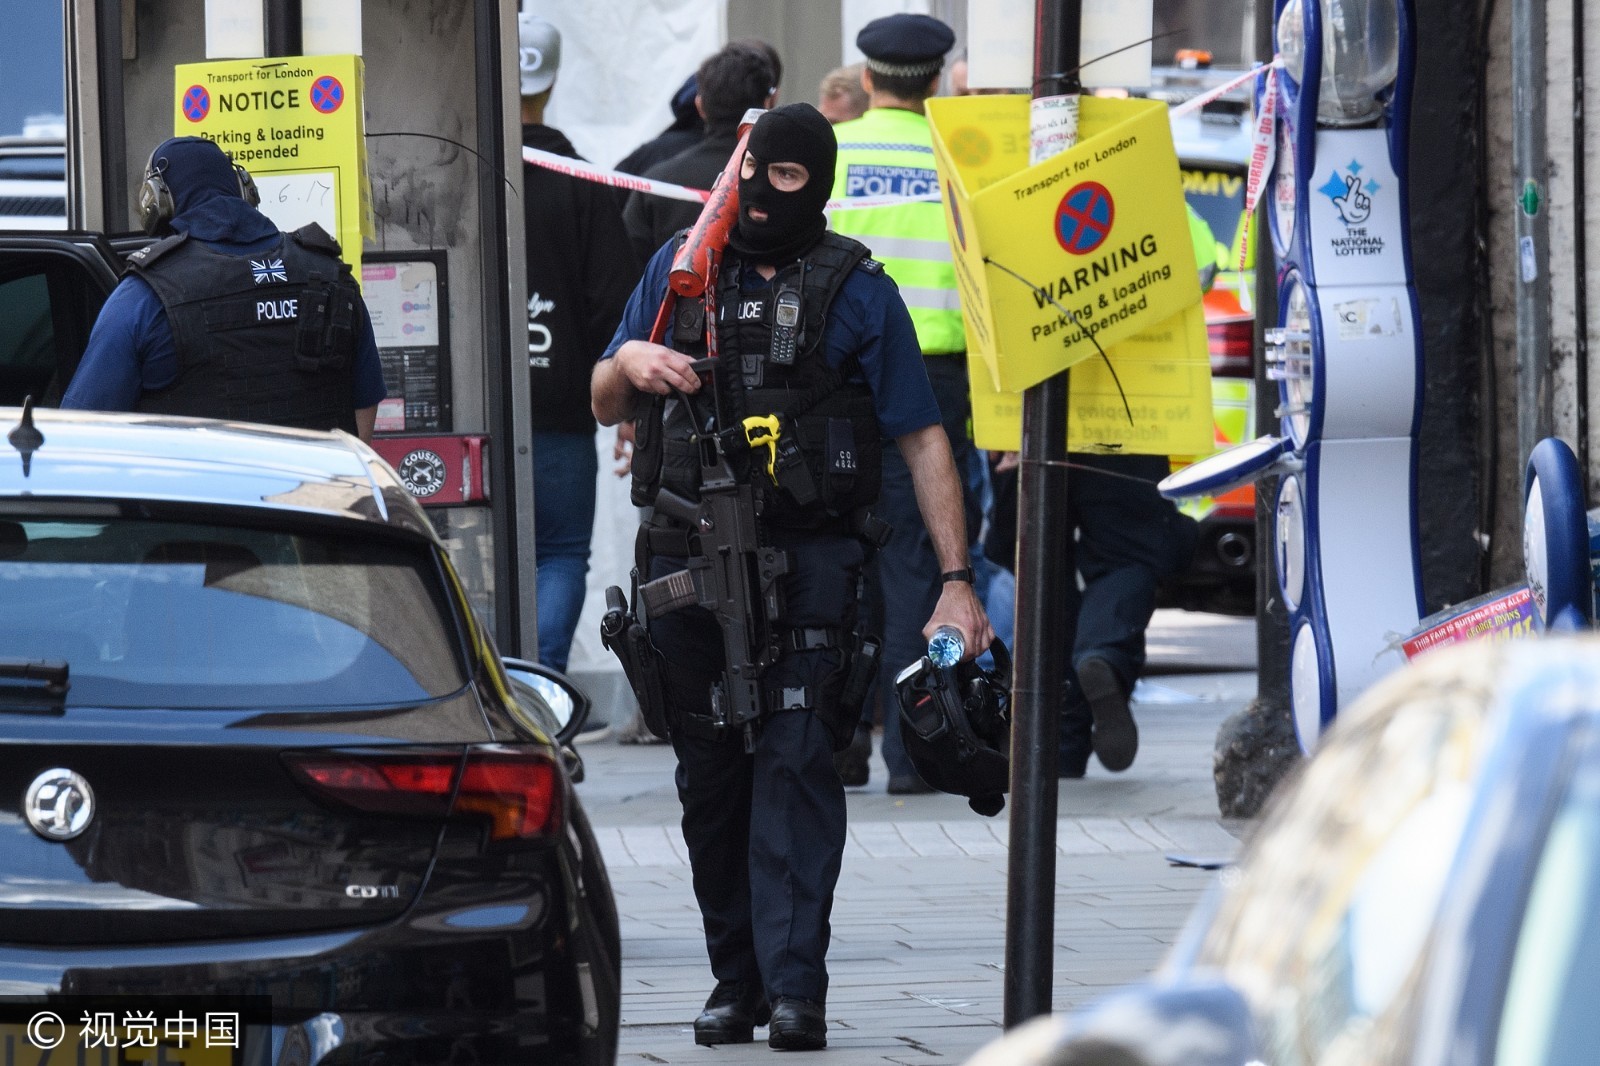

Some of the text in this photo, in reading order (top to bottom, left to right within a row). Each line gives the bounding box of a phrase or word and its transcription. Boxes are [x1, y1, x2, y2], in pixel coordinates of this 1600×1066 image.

[207, 68, 313, 84] Transport for London
[219, 89, 300, 113] NOTICE
[201, 126, 324, 145] Parking & loading
[1246, 145, 1269, 194] CORDON
[1259, 114, 1273, 135] DO
[849, 165, 938, 180] METROPOLITA
[1014, 168, 1071, 200] Transport
[1073, 159, 1091, 173] for
[1094, 135, 1137, 162] London
[1331, 237, 1385, 247] NATIONAL
[1346, 228, 1367, 237] THE
[1335, 247, 1382, 256] LOTTERY
[1033, 233, 1158, 310] WARNING
[256, 299, 298, 321] POLICE
[1031, 263, 1172, 342] Parking & loading
[1063, 294, 1148, 348] suspended
[529, 356, 550, 368] NCE
[404, 451, 442, 468] COUSIN
[401, 478, 443, 495] LONDON
[1414, 635, 1430, 650] THIS
[1429, 628, 1446, 645] FAIR
[1446, 624, 1454, 634] IS
[1454, 609, 1490, 631] SUITABLE
[1490, 602, 1507, 616] FOR
[1507, 595, 1521, 609] ALL
